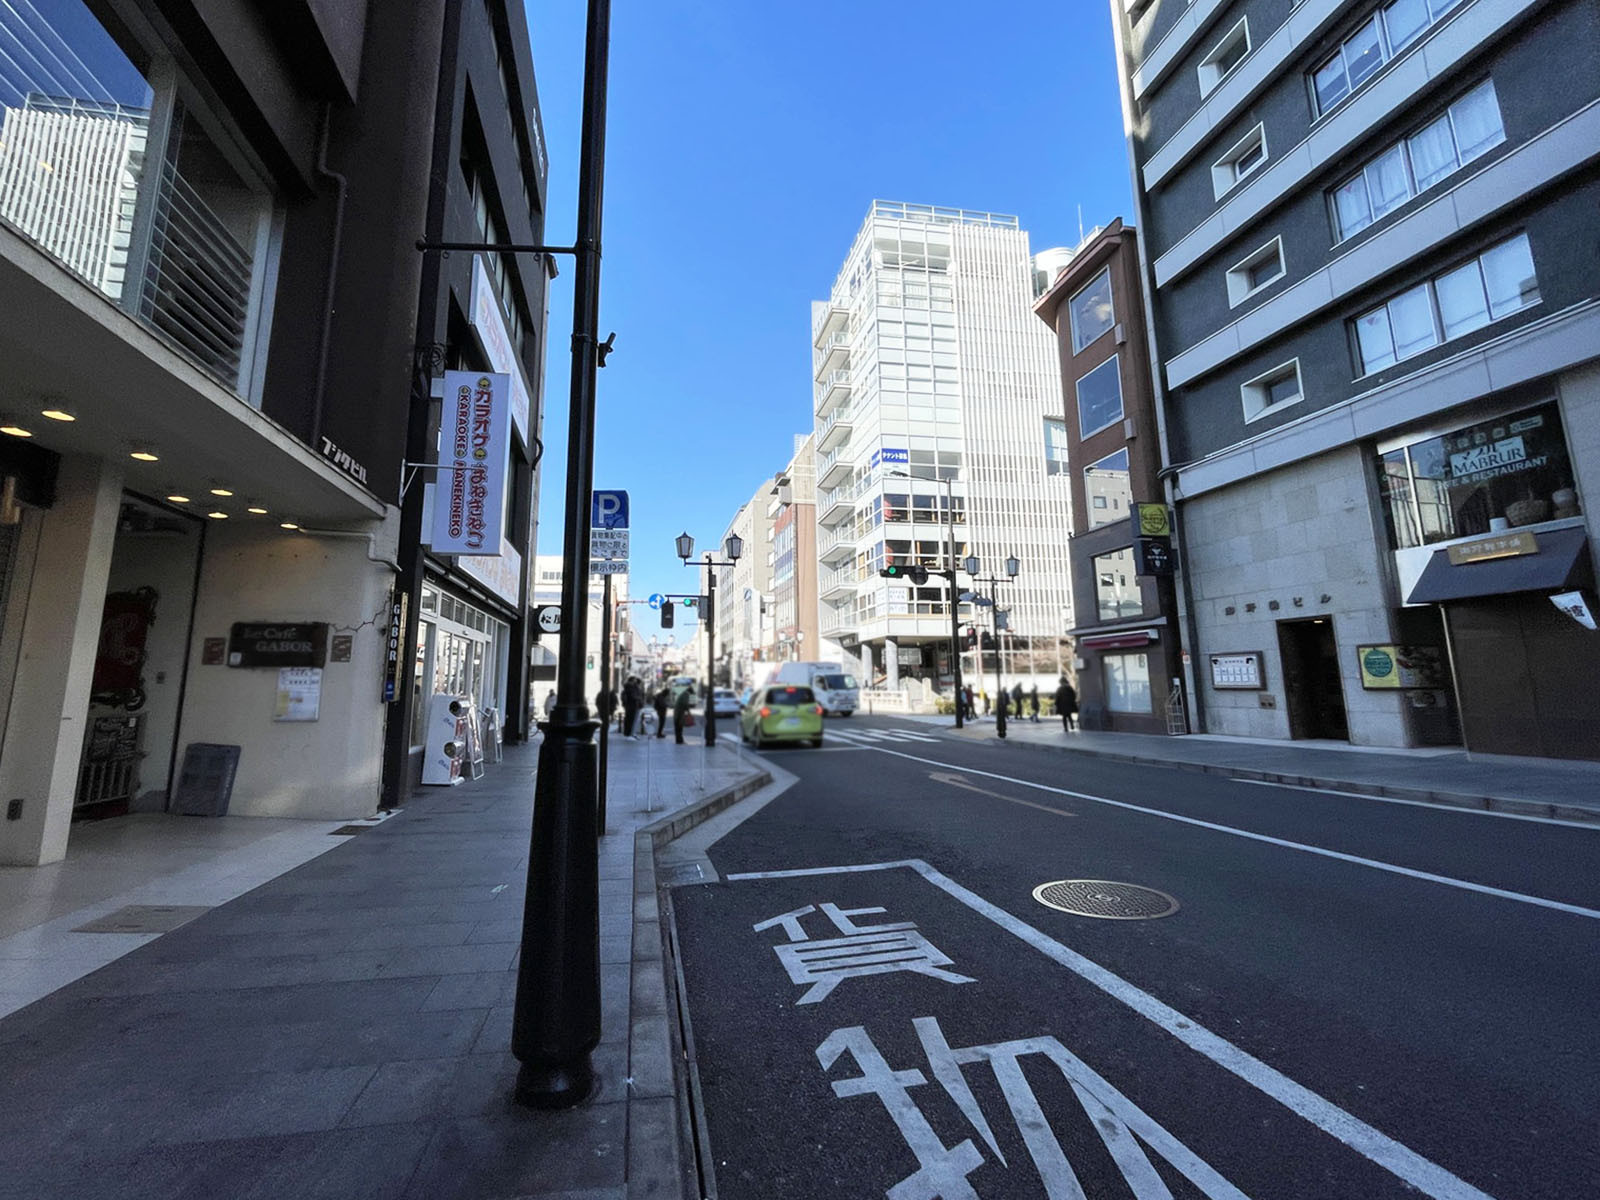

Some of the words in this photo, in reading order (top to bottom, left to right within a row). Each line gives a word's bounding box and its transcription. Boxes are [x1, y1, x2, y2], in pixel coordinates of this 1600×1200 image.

[457, 394, 470, 449] KARAOKE
[474, 389, 492, 447] カラオケ
[1453, 447, 1524, 476] MABRUR
[1472, 455, 1548, 482] RESTAURANT
[450, 461, 465, 537] MANEKINEKO
[598, 494, 621, 524] P
[255, 640, 313, 652] GABOR
[389, 604, 400, 661] GABOR
